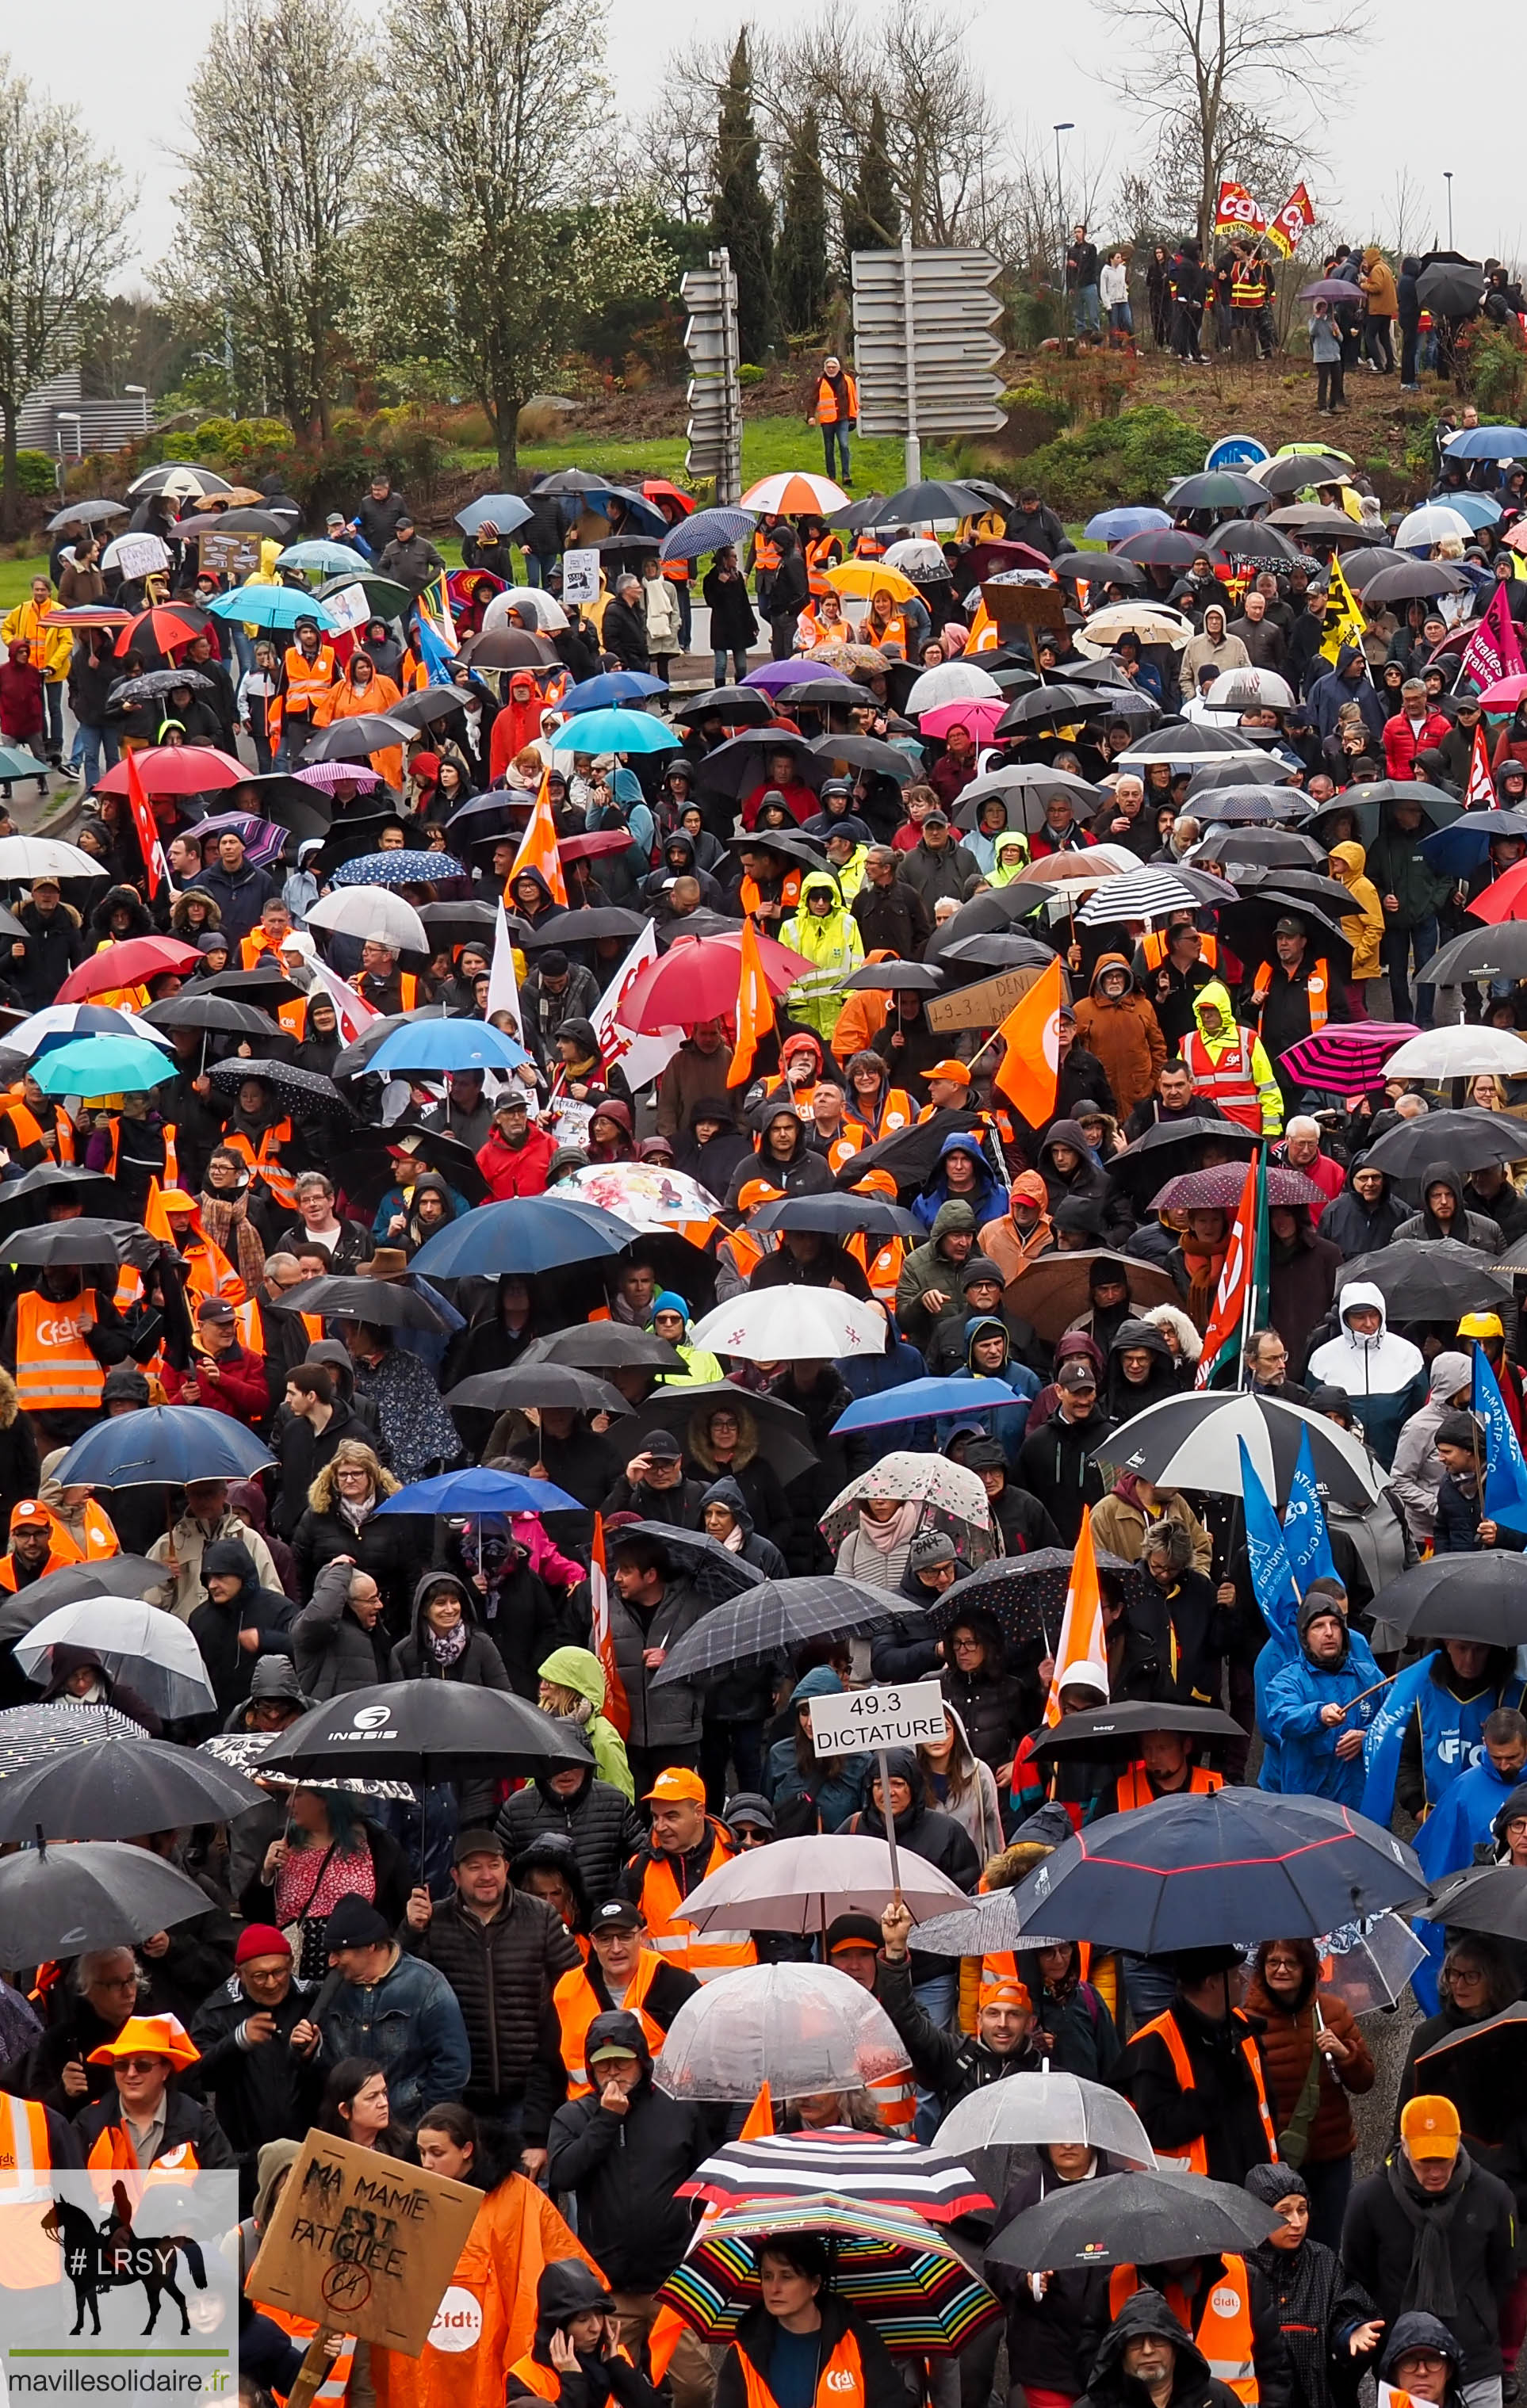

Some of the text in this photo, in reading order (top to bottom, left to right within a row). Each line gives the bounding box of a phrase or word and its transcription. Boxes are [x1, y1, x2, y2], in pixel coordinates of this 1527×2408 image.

[850, 1692, 901, 1716] 49.3
[328, 1730, 399, 1741] INESIS
[817, 1717, 944, 1749] DICTATURE
[303, 2157, 430, 2221] MA MAMIE
